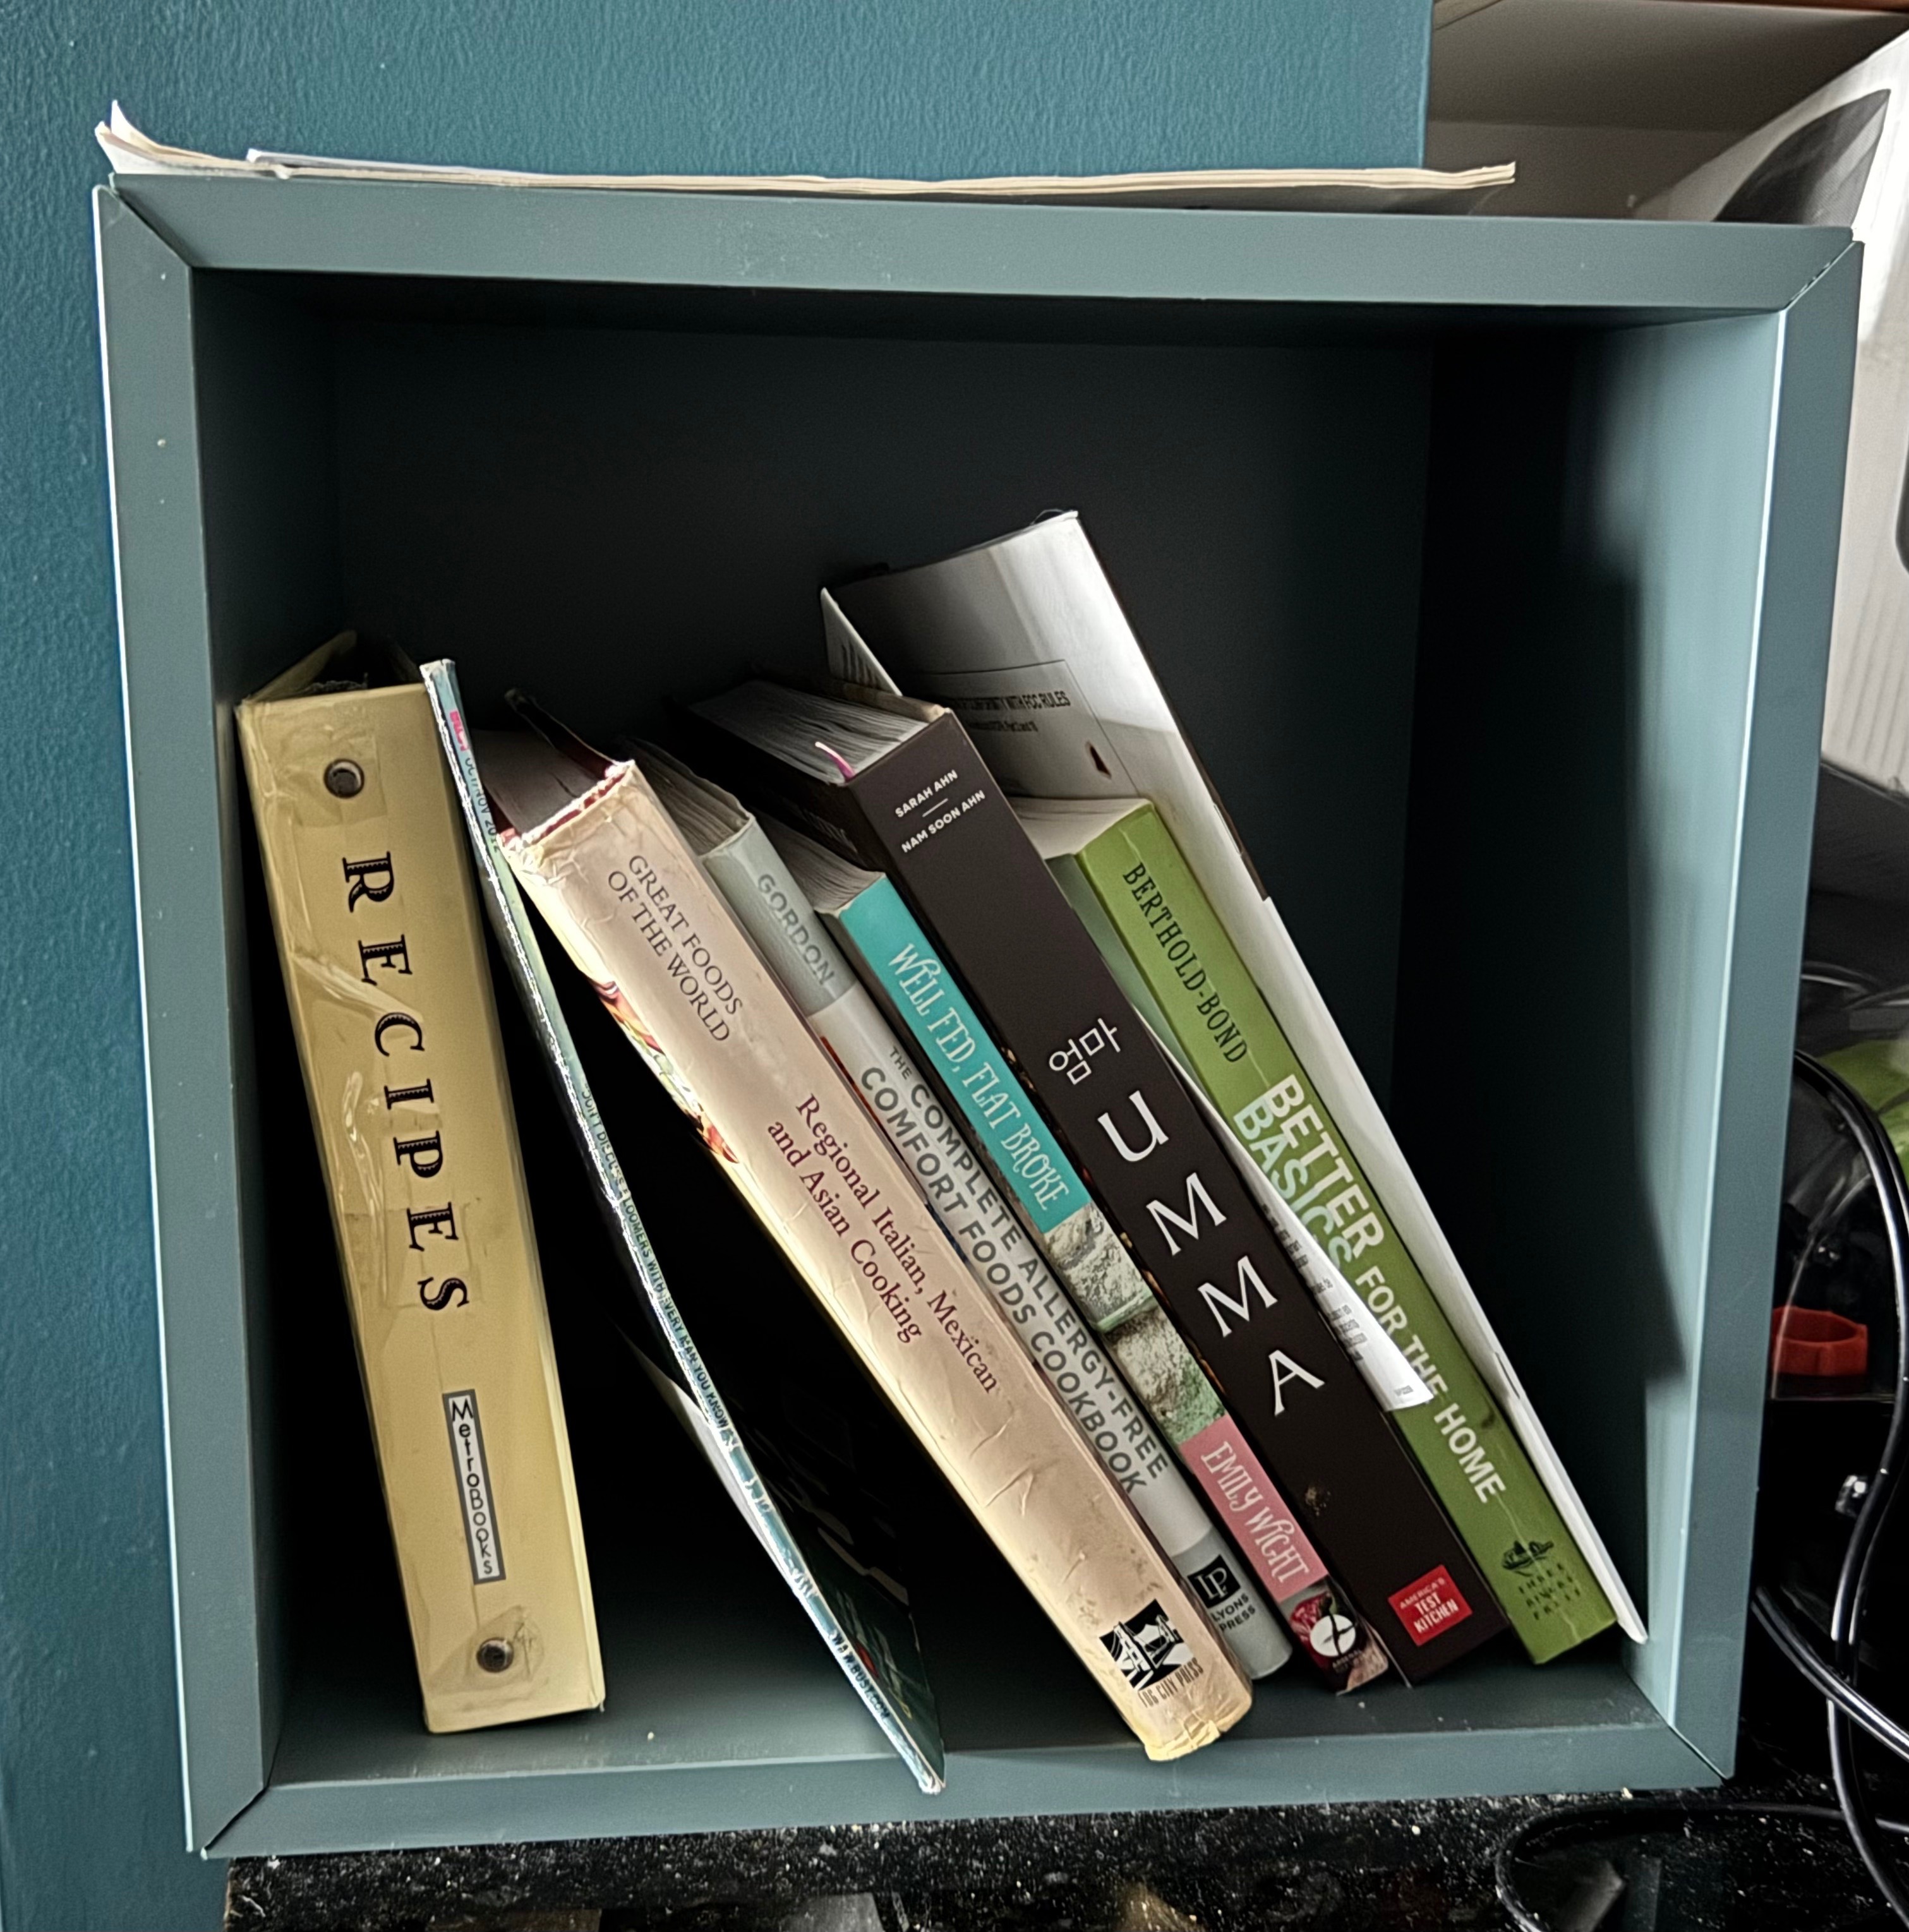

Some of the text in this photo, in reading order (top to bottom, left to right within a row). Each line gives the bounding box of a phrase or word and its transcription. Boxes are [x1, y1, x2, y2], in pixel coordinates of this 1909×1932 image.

[1039, 690, 1071, 709] RULES
[894, 769, 958, 819] SARAH AHN
[901, 789, 986, 854] NAM SOON AHN
[608, 870, 730, 1041] OF THE WORLD
[629, 855, 743, 1016] GREAT FOODS
[758, 873, 835, 985] GORDON
[1123, 861, 1248, 1064] BERTHOLD-BOND
[342, 851, 470, 1312] RECIPES
[888, 943, 1070, 1211] WELL FED, FLAT BROKE
[1049, 1017, 1121, 1085] 엄마
[768, 1121, 922, 1344] and Asian Cooking
[796, 1093, 1001, 1393] Regional Italian, Mexican
[1097, 1090, 1325, 1417] UMMA
[1232, 1094, 1353, 1269] BASICS
[861, 1067, 1147, 1492] COMFORT FOODS COOKBOOK
[888, 1046, 1169, 1479] THE COMPLETE ALLERGY-FREE
[1264, 1074, 1385, 1259] BETTER
[1355, 1265, 1409, 1334] FOR
[1404, 1334, 1448, 1396] THE
[1433, 1403, 1506, 1503] HOME
[694, 1362, 711, 1391] YOU
[706, 1391, 730, 1428] KNOW
[450, 1398, 493, 1575] MetroBooks
[1200, 1441, 1310, 1583] EMILY WIGHT
[1159, 1676, 1179, 1701] CITY
[1175, 1656, 1204, 1688] PRESS
[1210, 1593, 1250, 1621] LYONS
[1219, 1605, 1256, 1633] PRESS
[1413, 1599, 1459, 1634] KITCHEN
[1414, 1592, 1442, 1616] TEST
